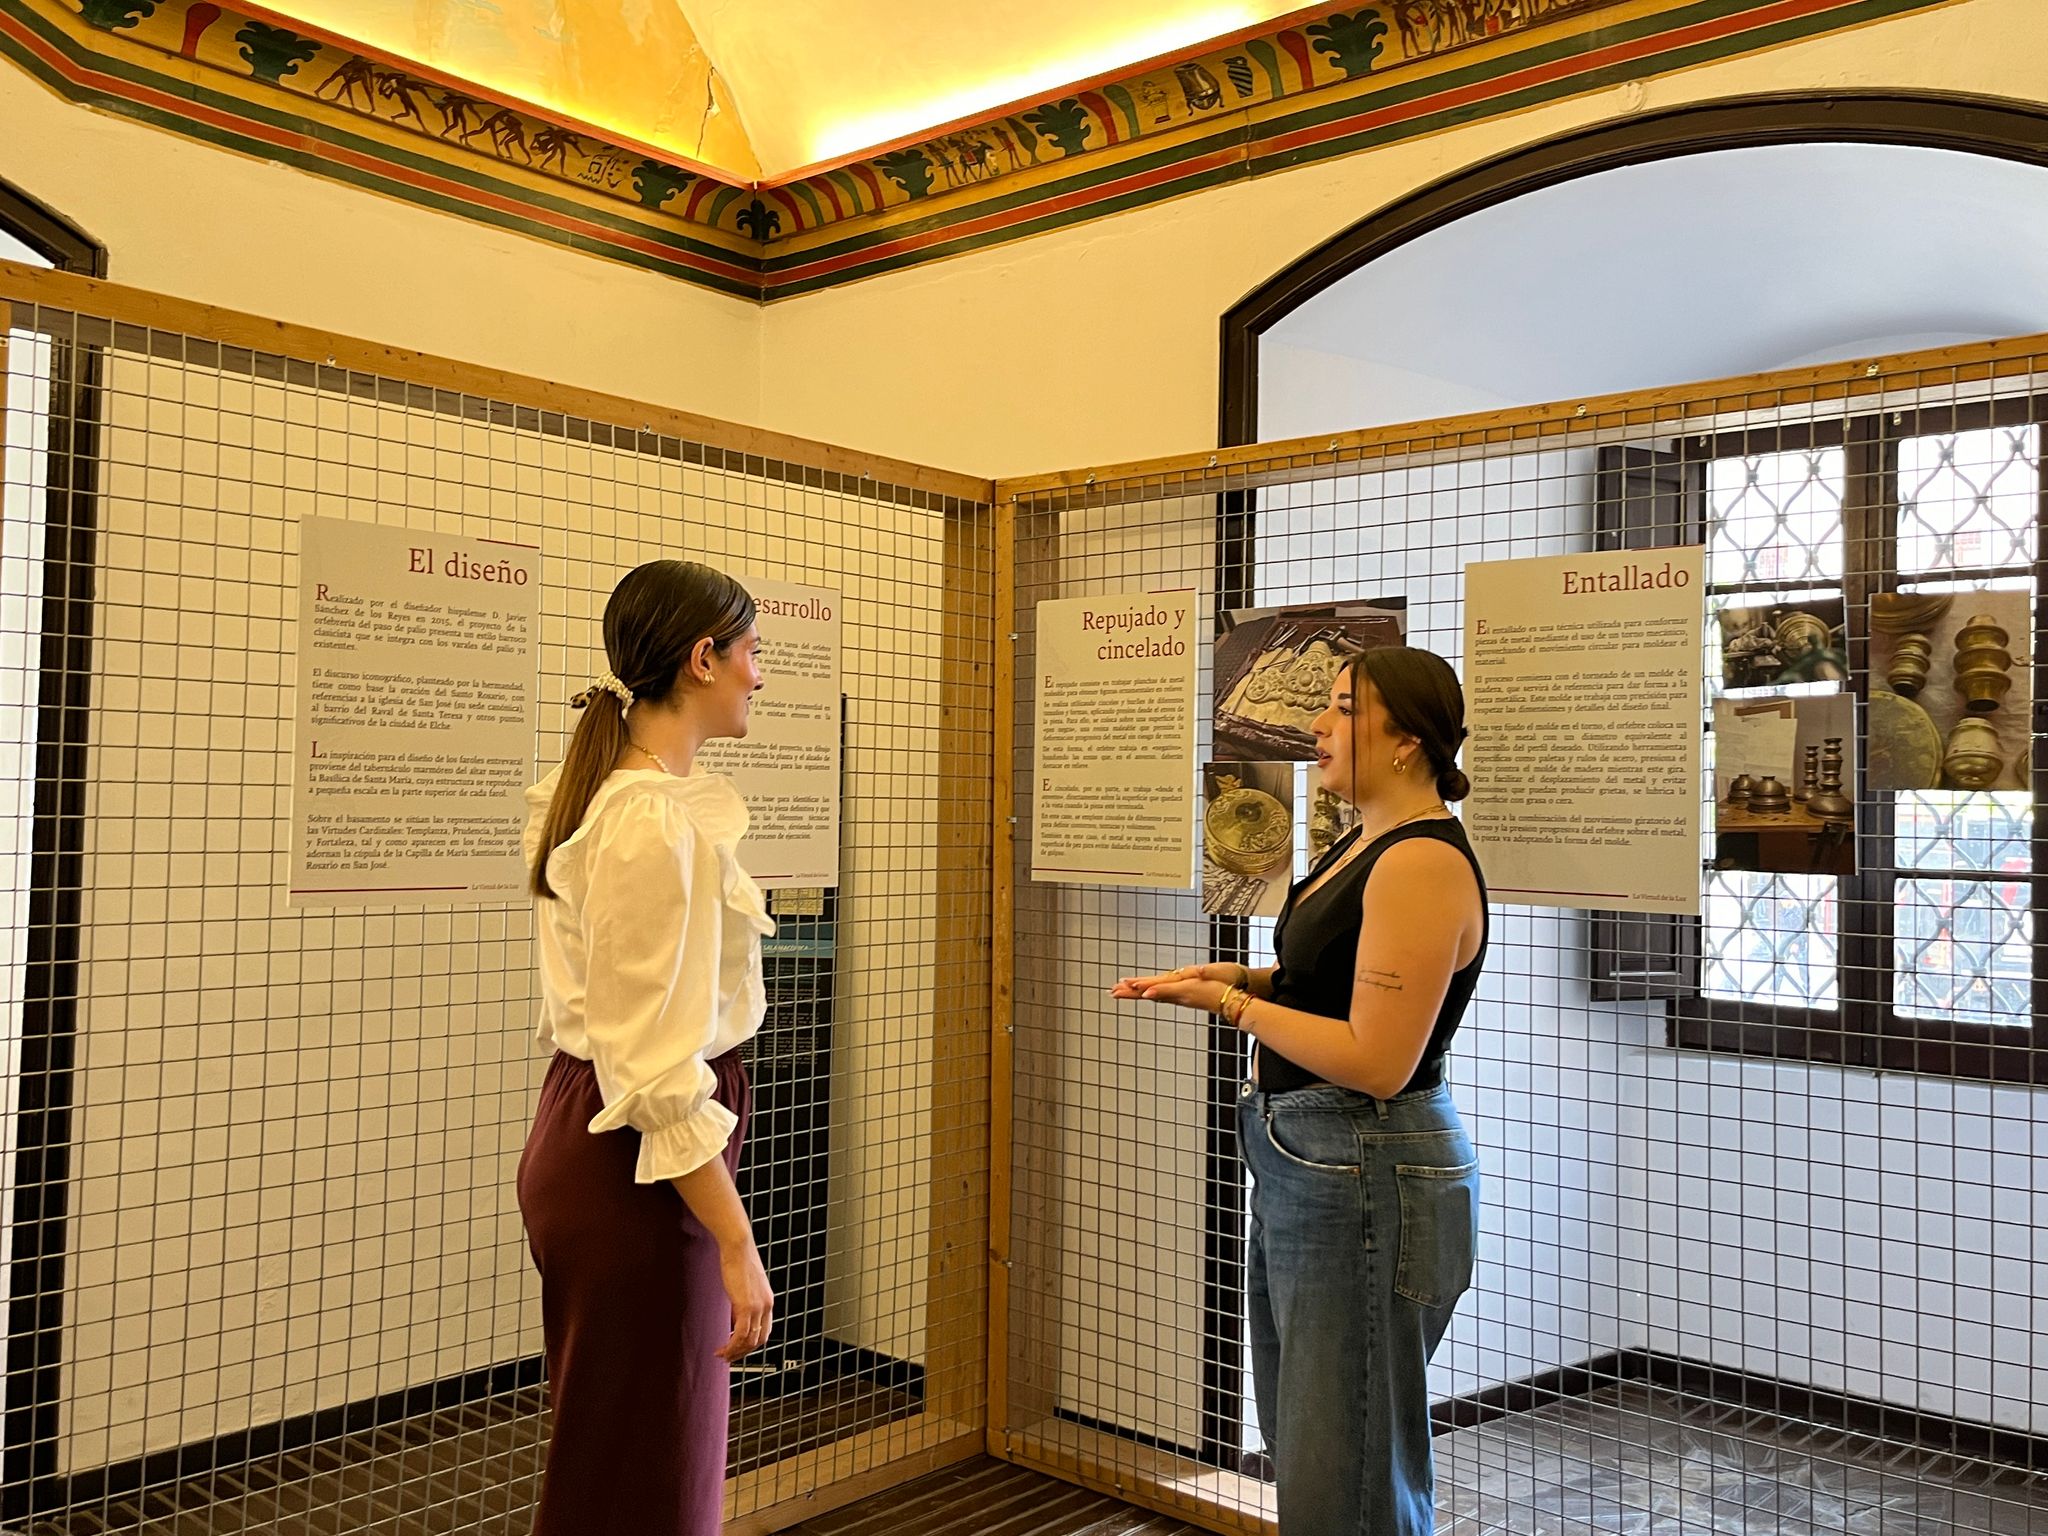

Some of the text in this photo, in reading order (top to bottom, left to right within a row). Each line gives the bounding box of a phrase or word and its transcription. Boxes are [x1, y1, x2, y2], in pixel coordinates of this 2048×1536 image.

[408, 548, 527, 585] El diseño
[1562, 562, 1689, 595] Entallado
[369, 600, 384, 609] por
[390, 600, 397, 608] el
[752, 598, 831, 621] esarrollo
[354, 608, 365, 616] de
[370, 609, 382, 618] los
[1082, 605, 1186, 634] Repujado y
[358, 620, 370, 628] del
[394, 623, 404, 631] de
[354, 633, 370, 641] que
[437, 638, 449, 646] los
[481, 642, 492, 650] del
[1097, 635, 1186, 660] cincelado
[312, 668, 321, 676] El
[434, 688, 446, 696] del
[367, 695, 375, 703] la
[406, 697, 416, 705] de
[418, 698, 433, 706] San
[397, 708, 407, 716] de
[367, 718, 377, 726] de
